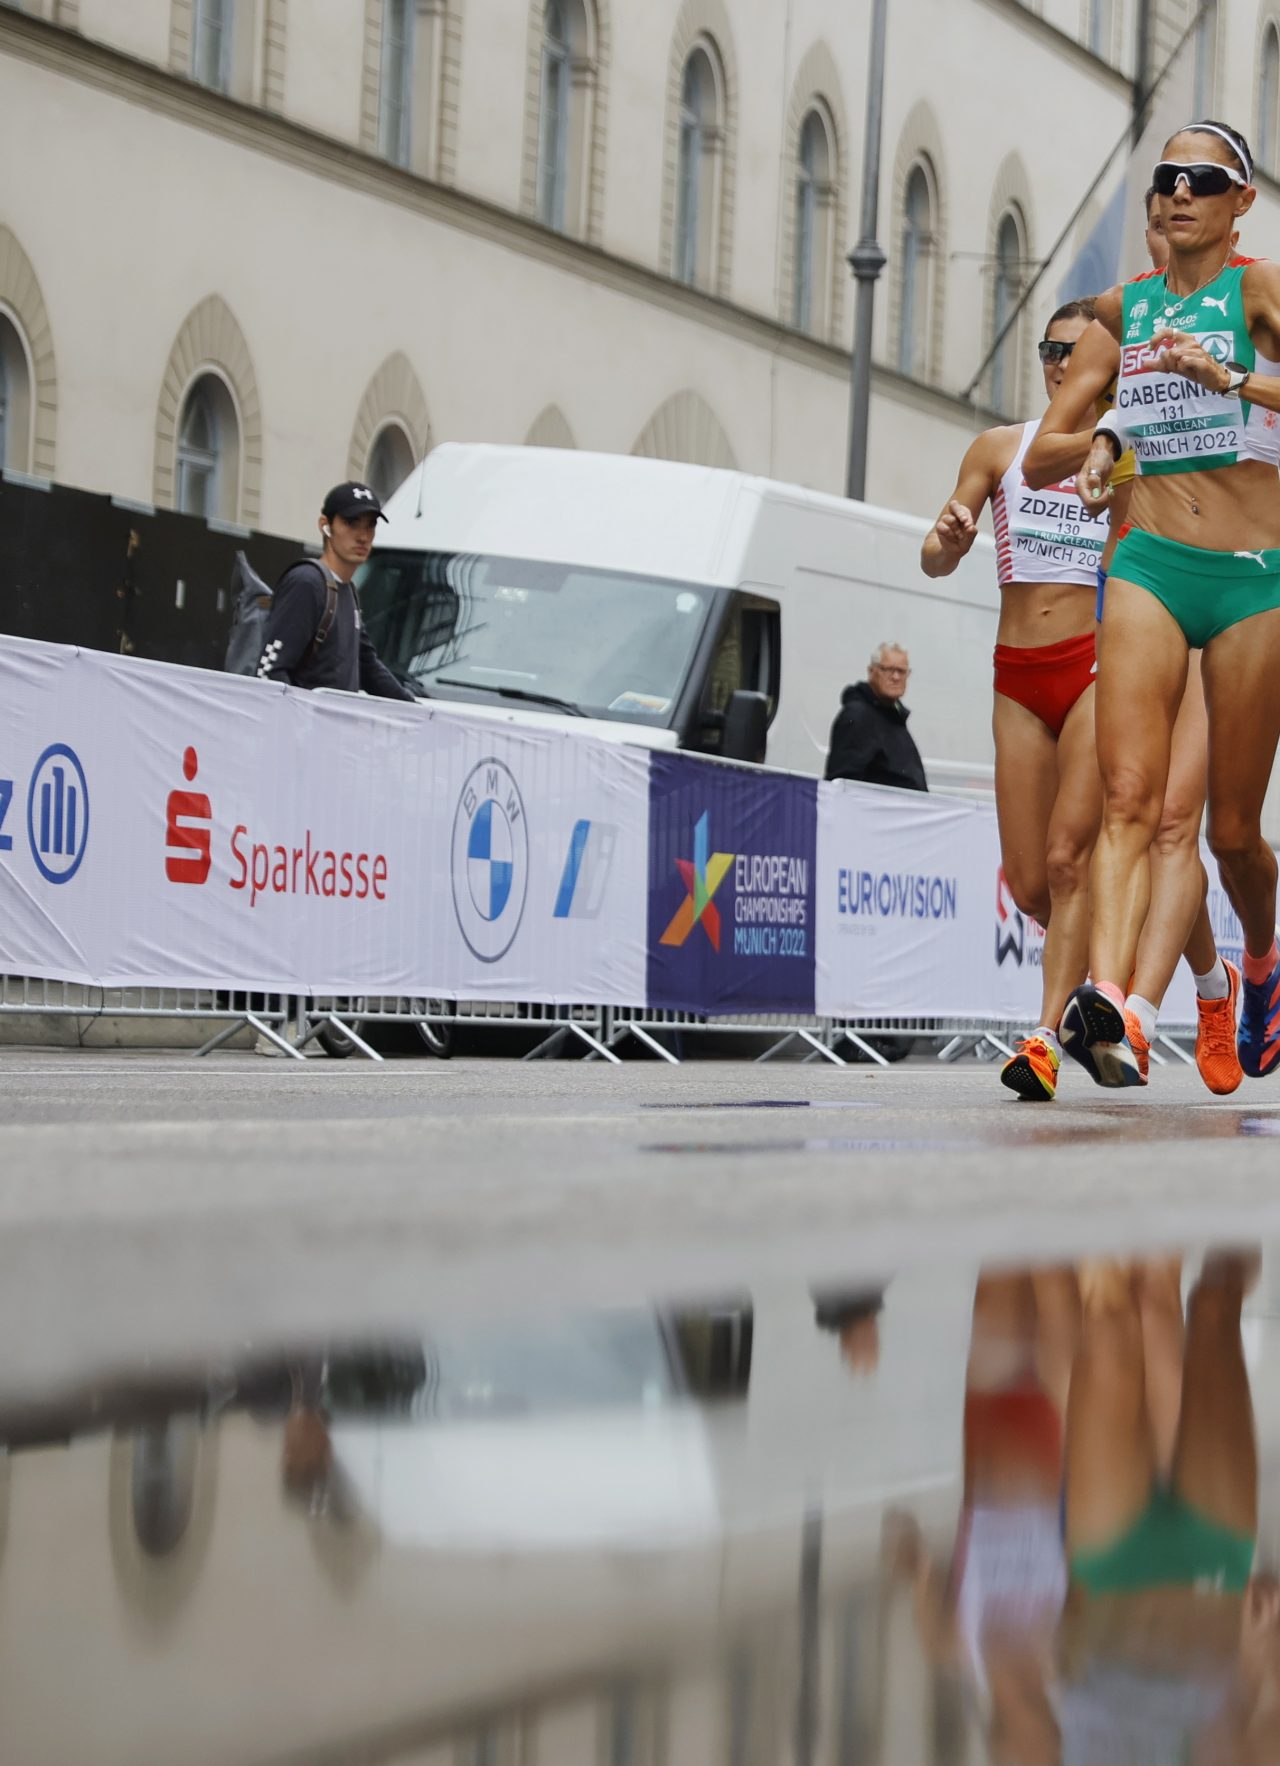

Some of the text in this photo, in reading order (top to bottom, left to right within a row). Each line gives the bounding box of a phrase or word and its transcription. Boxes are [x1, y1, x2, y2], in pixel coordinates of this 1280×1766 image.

[1120, 380, 1224, 408] CABECIN
[1160, 405, 1184, 420] 131
[1148, 422, 1171, 435] RUN
[1135, 430, 1238, 456] MUNICH 2022
[1019, 496, 1110, 526] ZDZIEBL
[1040, 532, 1061, 542] RUN
[1057, 523, 1080, 535] 130
[1017, 538, 1073, 561] MUNICH
[463, 769, 520, 823] BMW
[229, 825, 387, 907] Sparkasse
[735, 855, 807, 895] EUROPEAN
[838, 868, 957, 919] EUROVISION
[735, 896, 806, 924] CHAMPIONSHIPS
[734, 927, 776, 955] MUNICH
[779, 929, 806, 956] 2022
